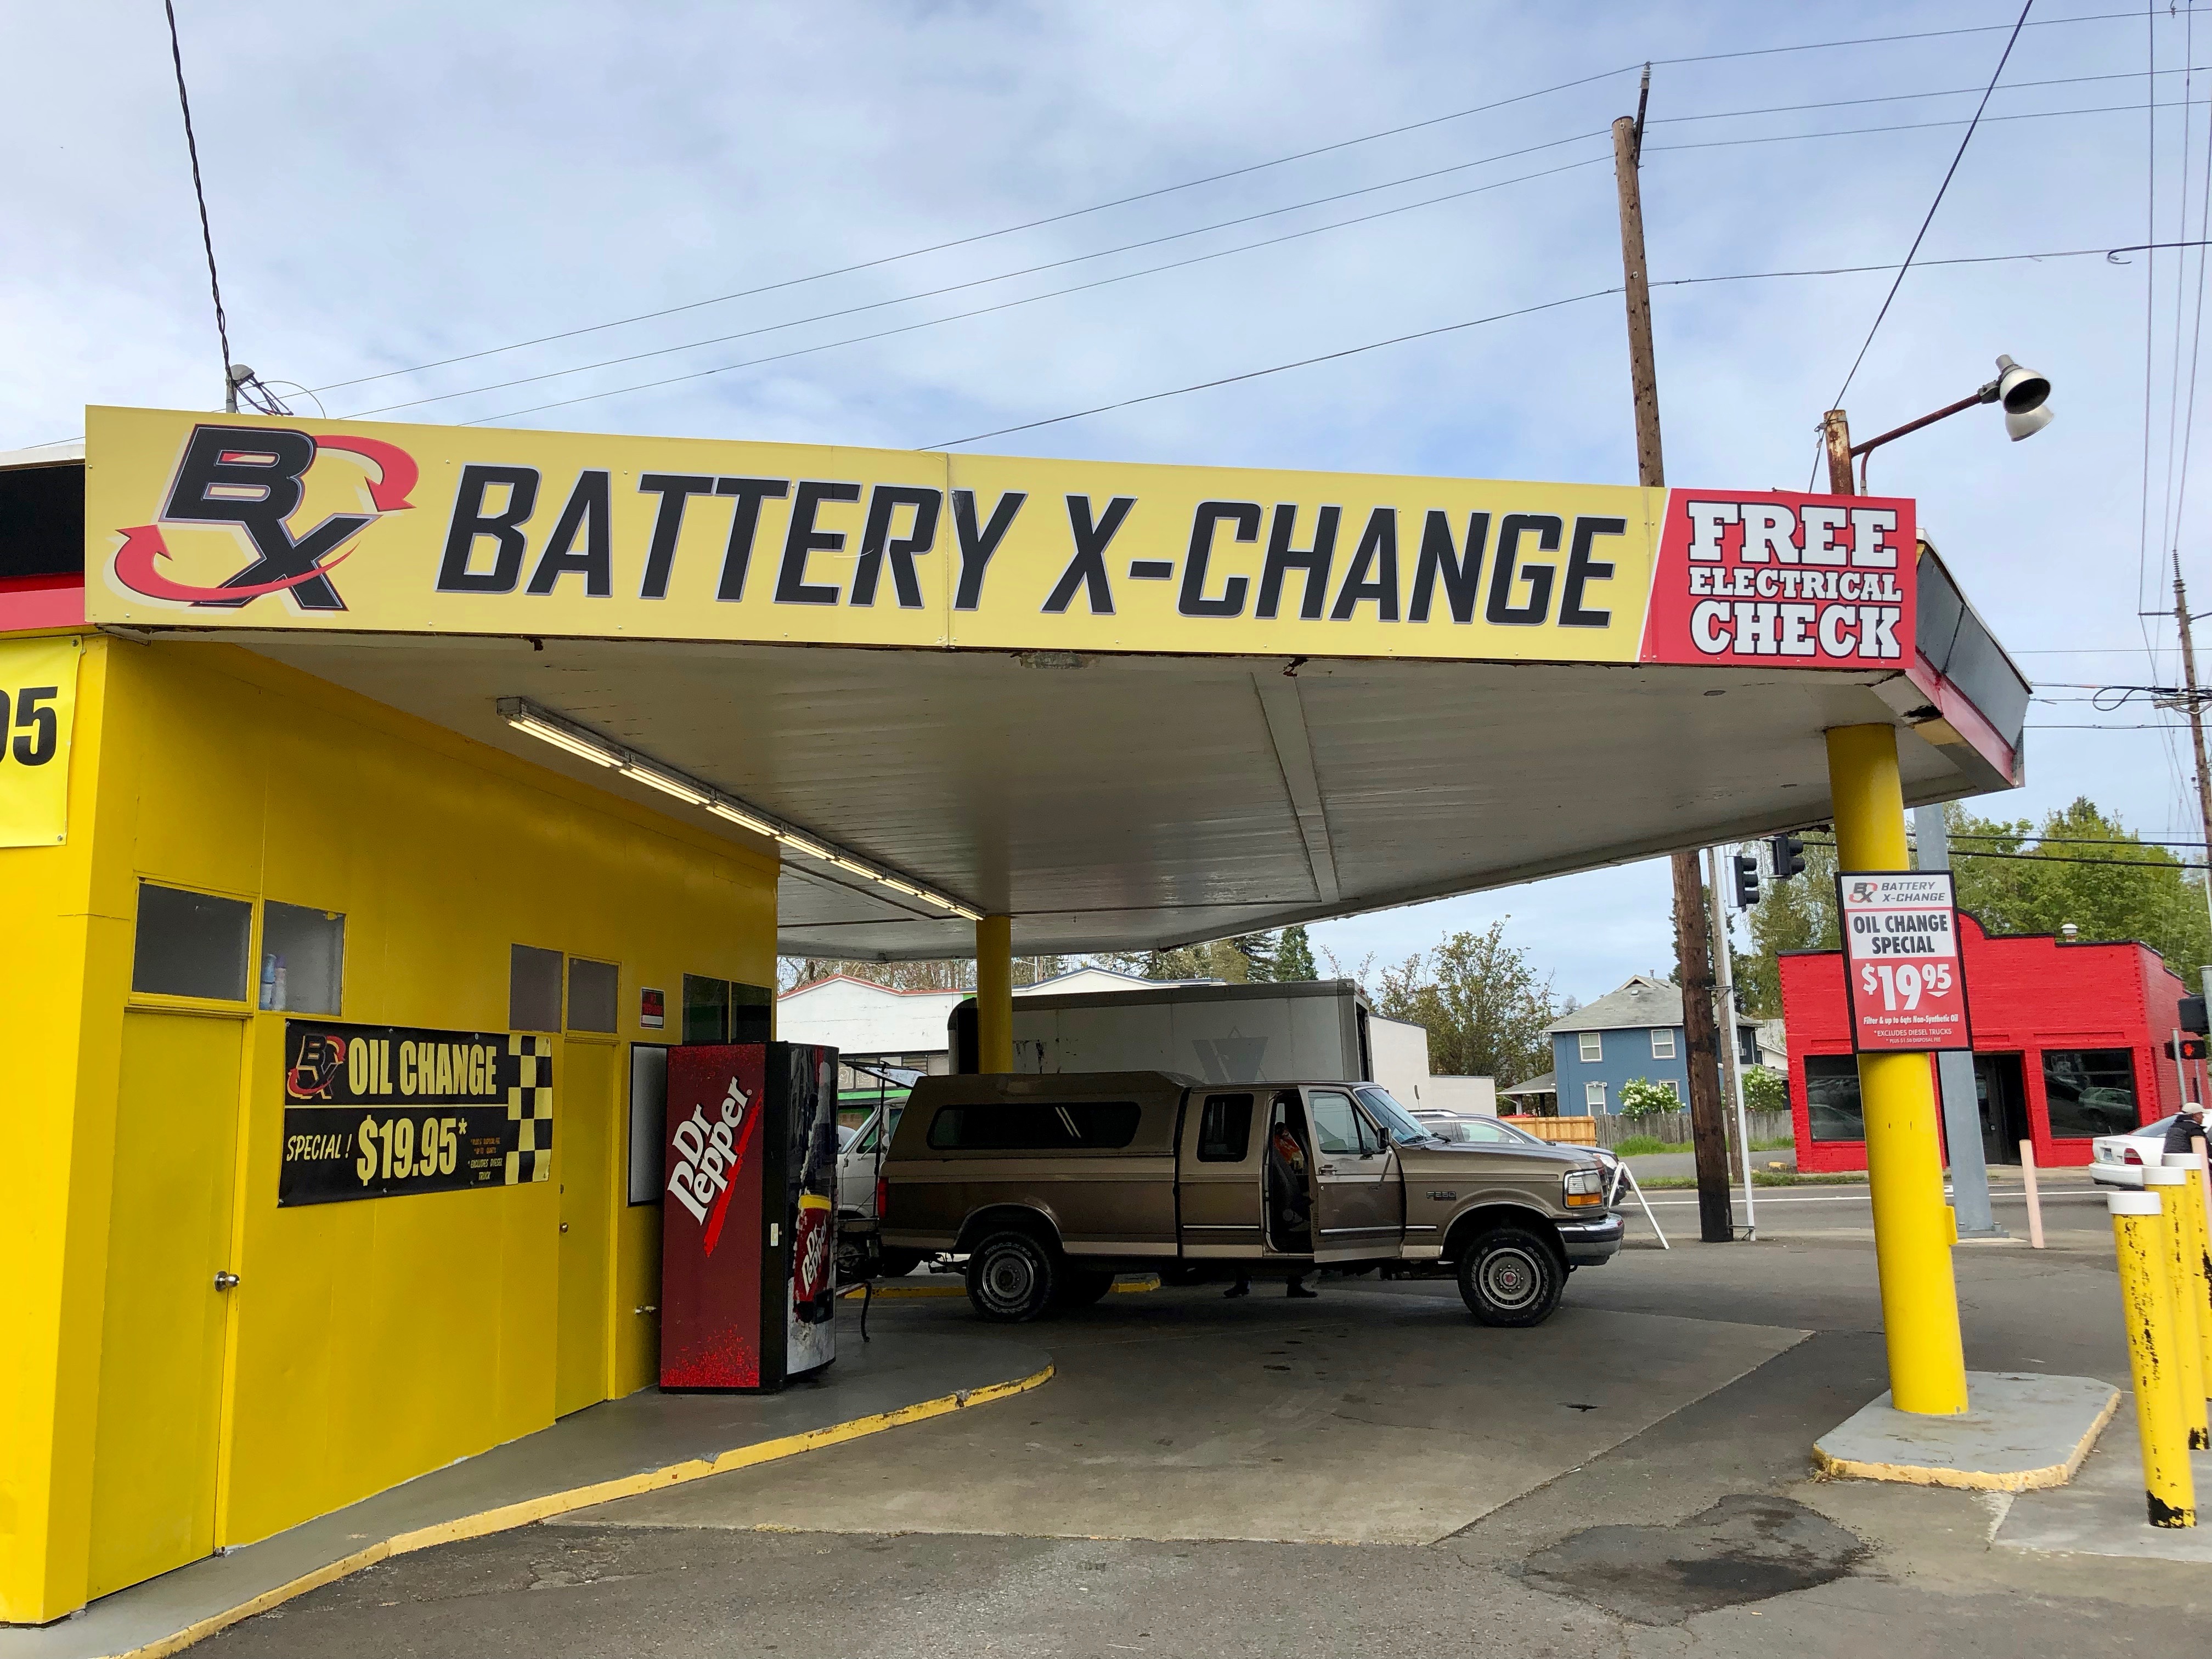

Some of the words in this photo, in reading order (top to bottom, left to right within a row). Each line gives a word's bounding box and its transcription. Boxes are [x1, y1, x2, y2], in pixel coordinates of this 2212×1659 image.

[434, 462, 1029, 612] BATTERY
[1040, 493, 1628, 629] X-CHANGE
[1686, 500, 1898, 569] FREE
[1688, 565, 1903, 602] ELECTRICAL
[1690, 598, 1901, 659] CHECK
[0, 686, 58, 766] 5
[1881, 882, 1936, 891] BATTERY
[1882, 893, 1946, 902] X-CHANGE
[1853, 915, 1881, 934] OIL
[1885, 914, 1948, 933] CHANGE
[1871, 936, 1936, 955] SPECIAL
[1864, 1016, 1878, 1025] Filter
[1879, 1016, 1884, 1024] &
[1885, 1017, 1892, 1025] up
[1950, 1014, 1959, 1023] Oil
[348, 1037, 393, 1096] OIL
[400, 1040, 497, 1096] CHANGE
[668, 1076, 749, 1226] Pepper
[672, 1103, 713, 1170] Dr
